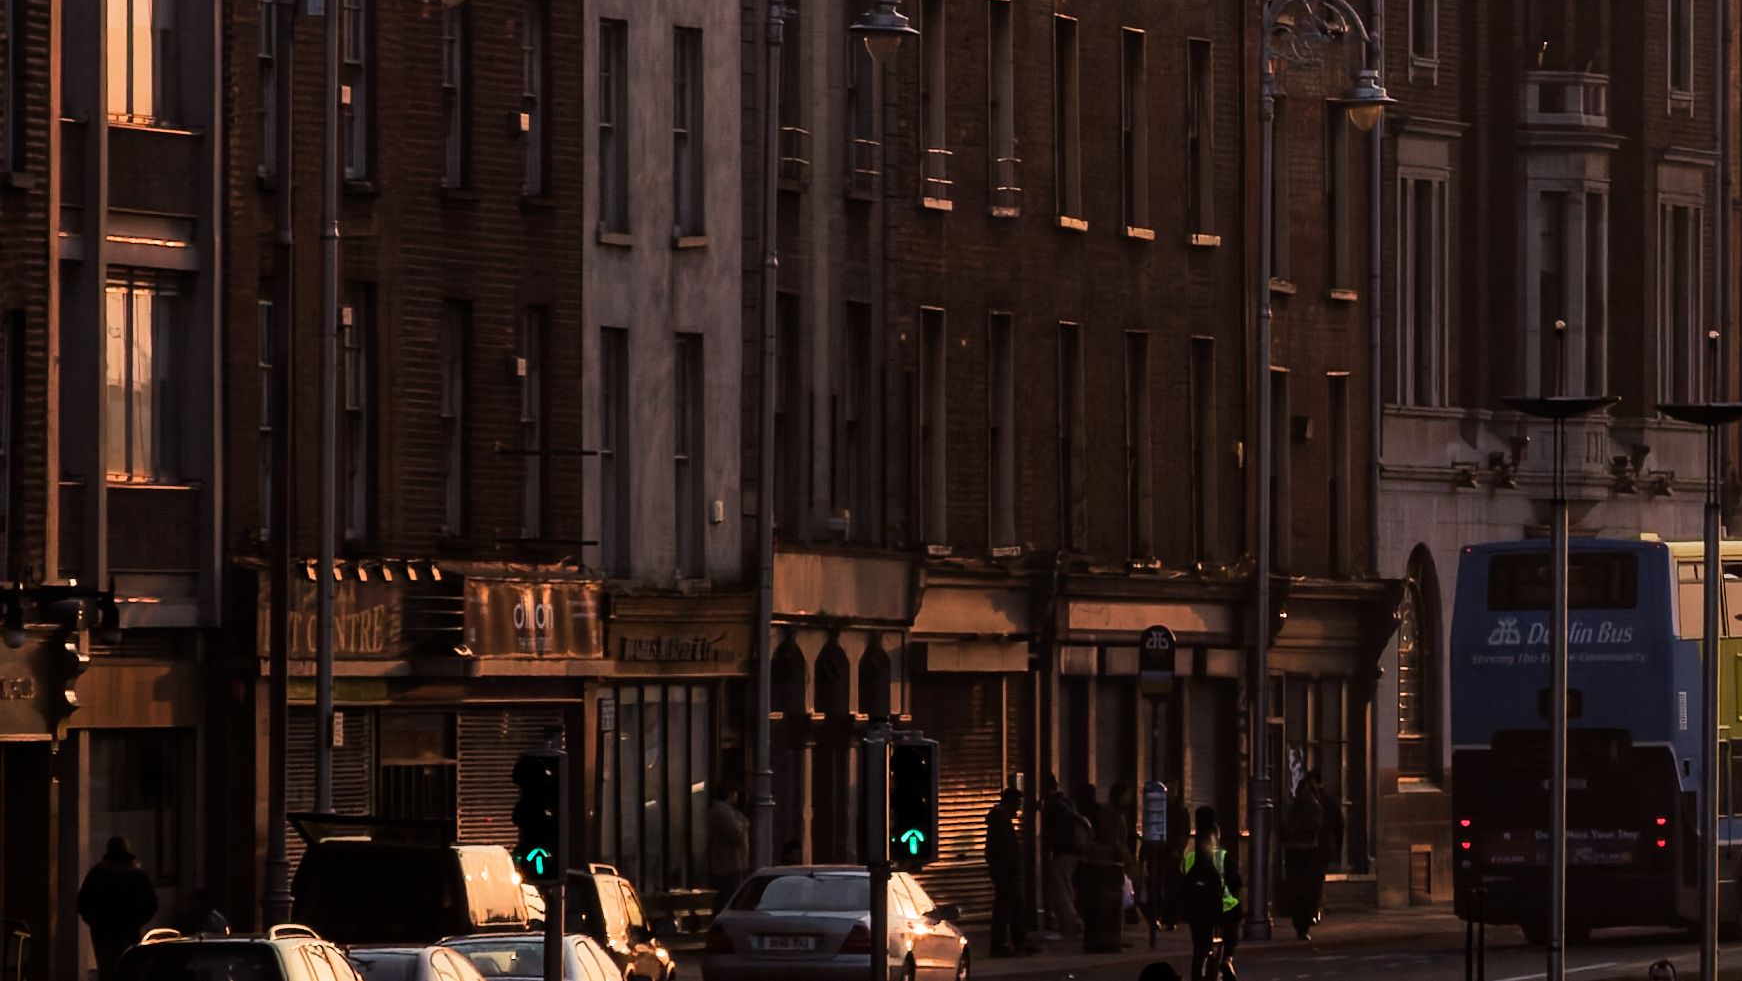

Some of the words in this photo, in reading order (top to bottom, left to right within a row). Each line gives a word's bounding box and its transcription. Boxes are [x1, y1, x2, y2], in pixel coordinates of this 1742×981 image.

[306, 603, 385, 653] CNTRE
[1527, 620, 1593, 645] Dulin
[1597, 621, 1633, 644] Bus
